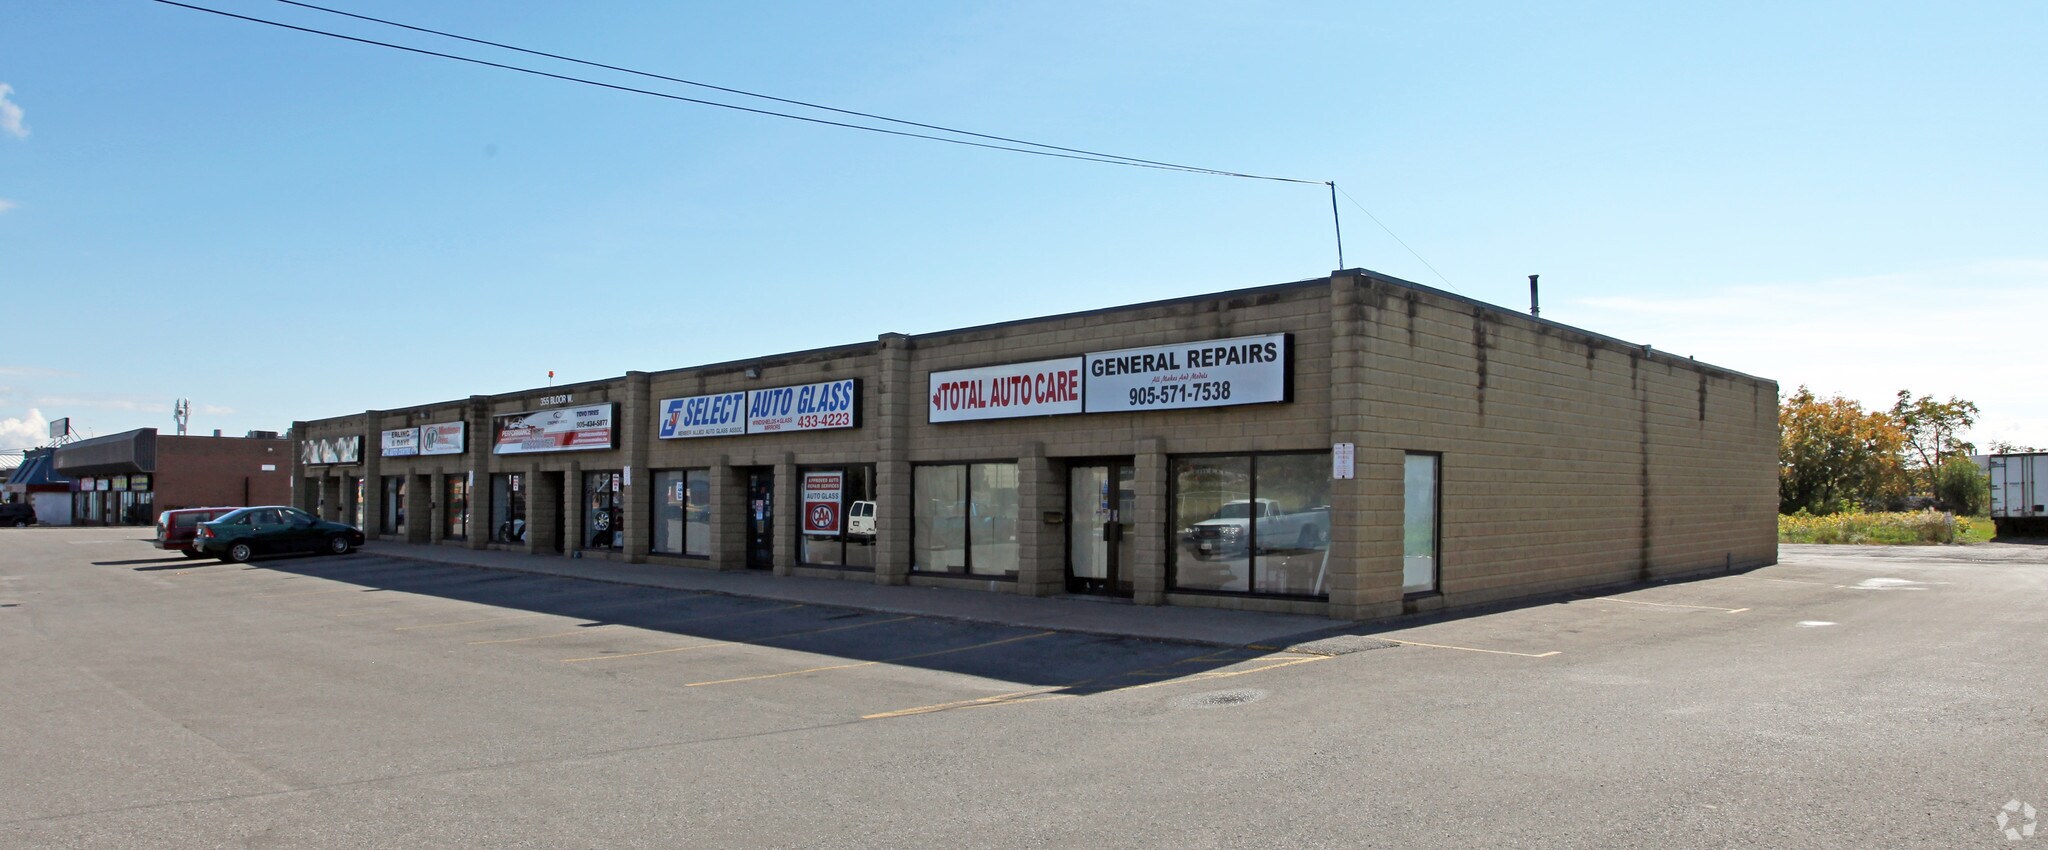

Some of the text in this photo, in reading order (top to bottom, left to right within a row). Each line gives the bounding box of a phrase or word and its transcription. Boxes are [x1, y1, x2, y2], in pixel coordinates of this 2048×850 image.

[1091, 342, 1277, 377] GENERAL REPAIRS
[941, 369, 1078, 411] TOTAL AUTO CARE
[1151, 372, 1208, 383] All Makes And Models
[540, 397, 550, 406] 355
[550, 394, 566, 405] BLOOR
[749, 381, 853, 418] AUTO GLASS
[1129, 380, 1231, 406] 905-571-7538
[683, 394, 744, 427] SELECT
[797, 412, 850, 428] 433-4223
[813, 507, 830, 525] CAA
